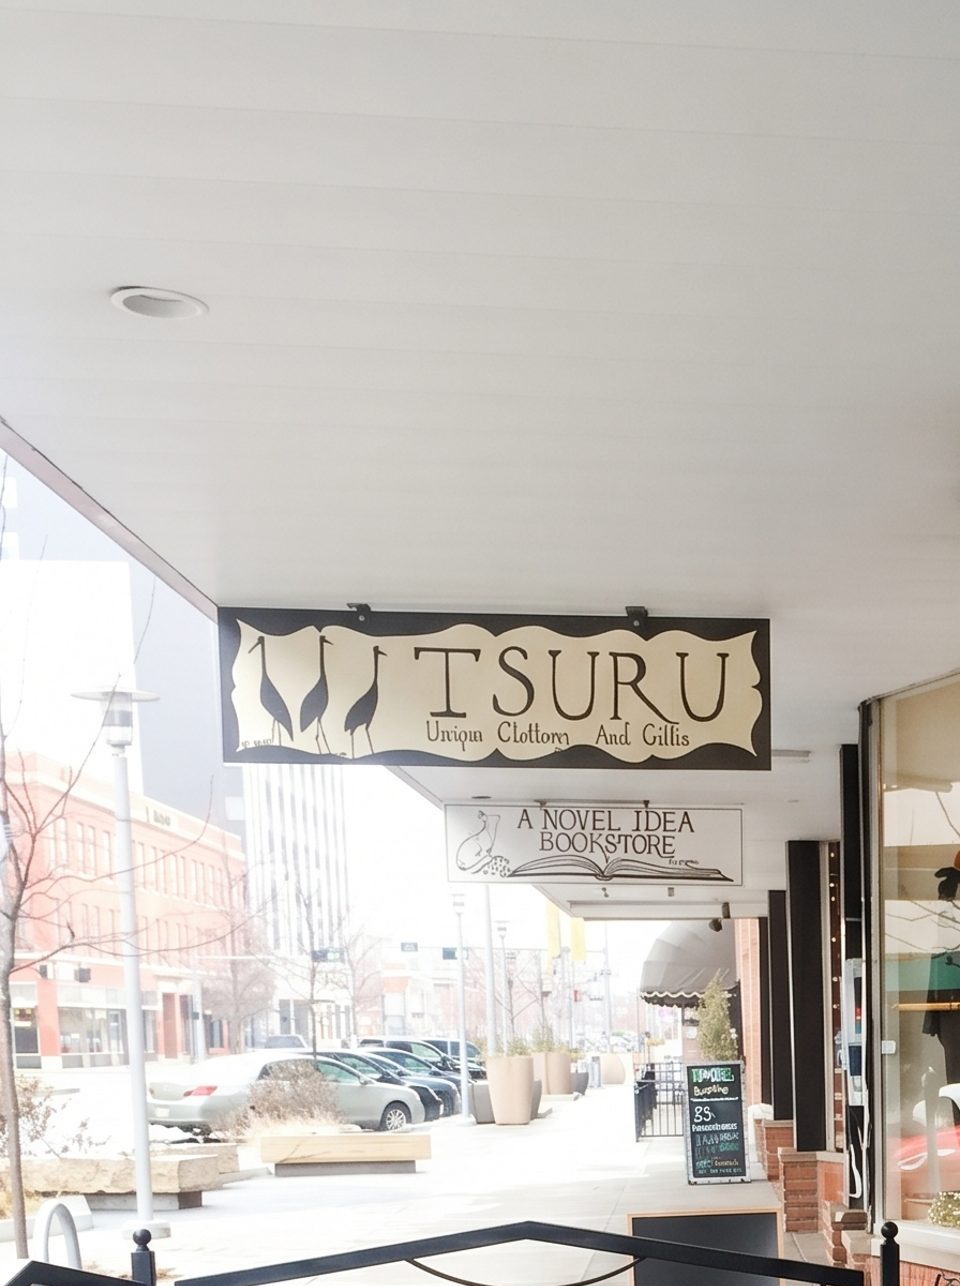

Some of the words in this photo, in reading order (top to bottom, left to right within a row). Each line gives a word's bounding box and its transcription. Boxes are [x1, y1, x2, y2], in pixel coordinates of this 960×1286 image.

[414, 645, 729, 725] TSURU
[595, 721, 631, 746] And
[517, 808, 533, 830] A
[542, 809, 621, 832] NOVEL
[632, 810, 695, 833] IDEA
[539, 832, 676, 861] BOOKSTORE
